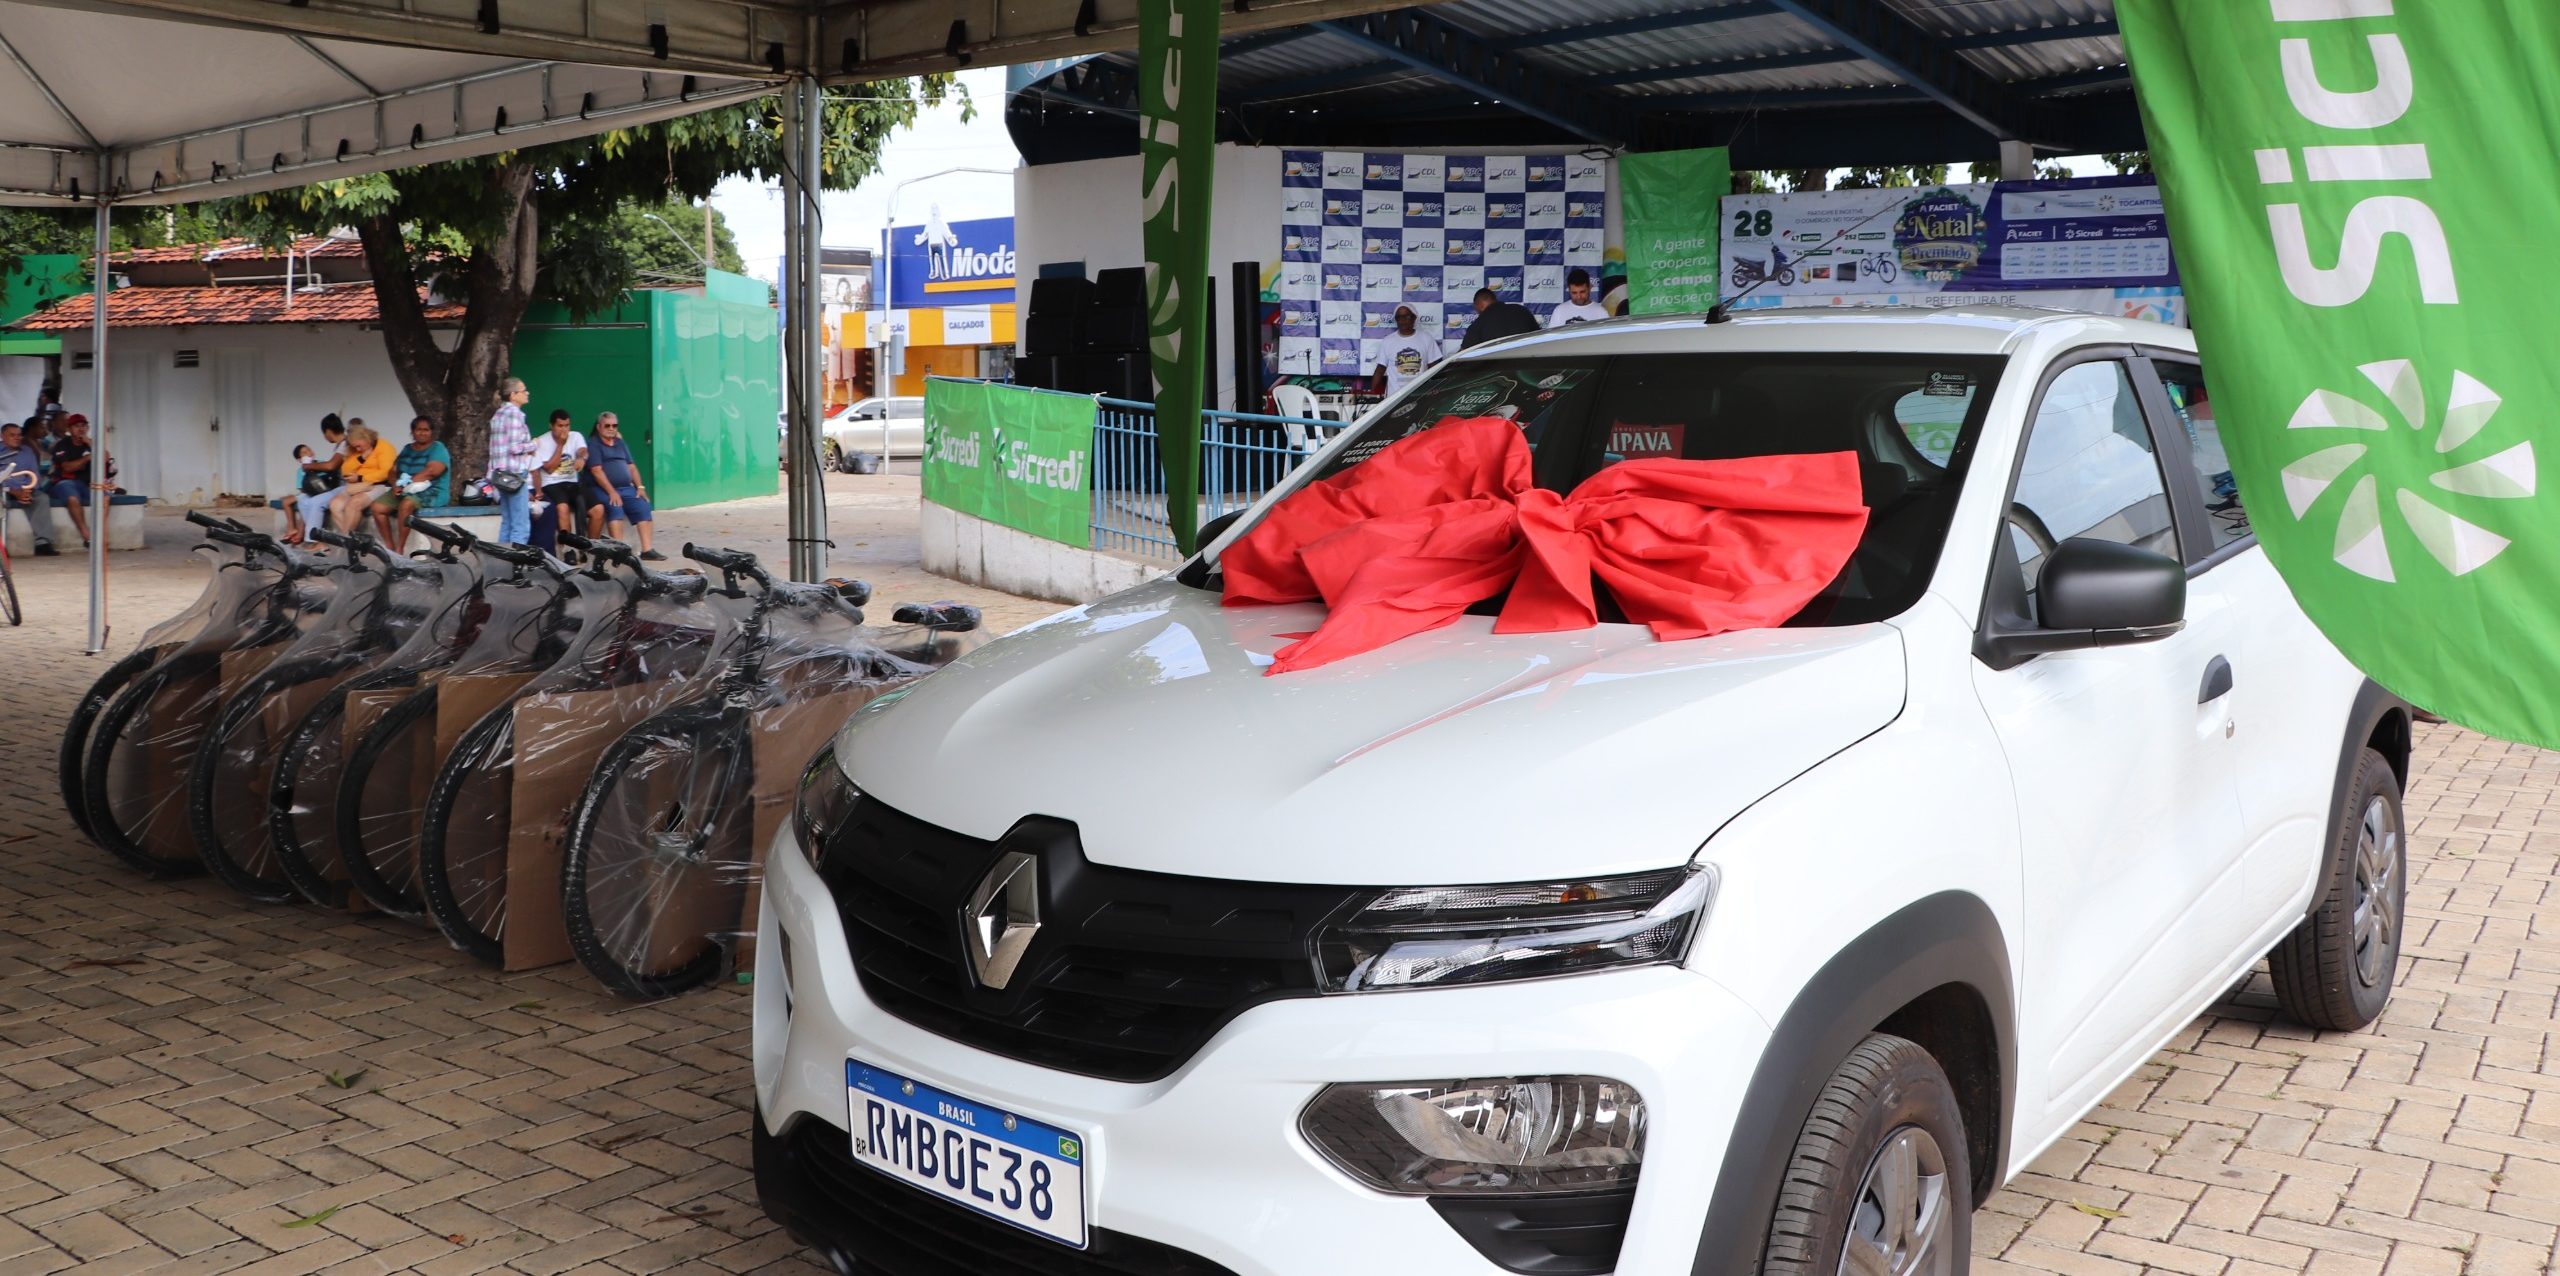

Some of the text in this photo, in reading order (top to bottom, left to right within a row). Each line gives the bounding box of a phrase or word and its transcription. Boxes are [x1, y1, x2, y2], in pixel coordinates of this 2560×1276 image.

[1302, 162, 1321, 172] SPC
[1340, 166, 1356, 174] CDL
[1383, 165, 1401, 176] SPC
[1421, 168, 1437, 176] CDL
[1464, 167, 1483, 176] SPC
[1502, 168, 1517, 176] CDL
[1545, 167, 1563, 176] SPC
[1582, 167, 1598, 175] CDL
[1342, 201, 1360, 210] SPC
[1379, 203, 1395, 211] CDL
[1423, 203, 1442, 212] SPC
[1504, 203, 1523, 212] SPC
[1584, 202, 1602, 211] SPC
[1928, 203, 1959, 212] FACIET
[1733, 209, 1773, 237] 28
[1908, 212, 1973, 240] Natal
[2075, 229, 2104, 238] Sicredi
[1301, 236, 1320, 247] SPC
[1339, 239, 1354, 247] CDL
[1381, 239, 1400, 249] SPC
[1420, 241, 1436, 249] CDL
[1464, 240, 1481, 250] SPC
[1544, 240, 1561, 249] SPC
[1653, 238, 1706, 253] A gente
[1909, 246, 1972, 260] Premiado
[951, 244, 1016, 277] Moda
[1651, 256, 1710, 269] coopera,
[1302, 274, 1317, 282] CDL
[1340, 275, 1359, 285] SPC
[1379, 277, 1394, 285] CDL
[1421, 277, 1439, 287] SPC
[1460, 278, 1476, 286] CDL
[1503, 277, 1521, 286] SPC
[1541, 278, 1555, 286] CDL
[1651, 274, 1713, 287] o campo
[1650, 292, 1713, 307] prospera
[1925, 295, 2016, 305] PREFEITURA DE
[1301, 311, 1319, 321] SPC
[948, 320, 985, 330] CALÇADOS
[1340, 350, 1359, 359] SPC
[1453, 392, 1499, 404] Natal
[938, 426, 980, 468] Sicredi
[1007, 440, 1085, 492] Sicredi
[938, 1100, 977, 1128] BRASIL
[856, 1136, 868, 1157] BR
